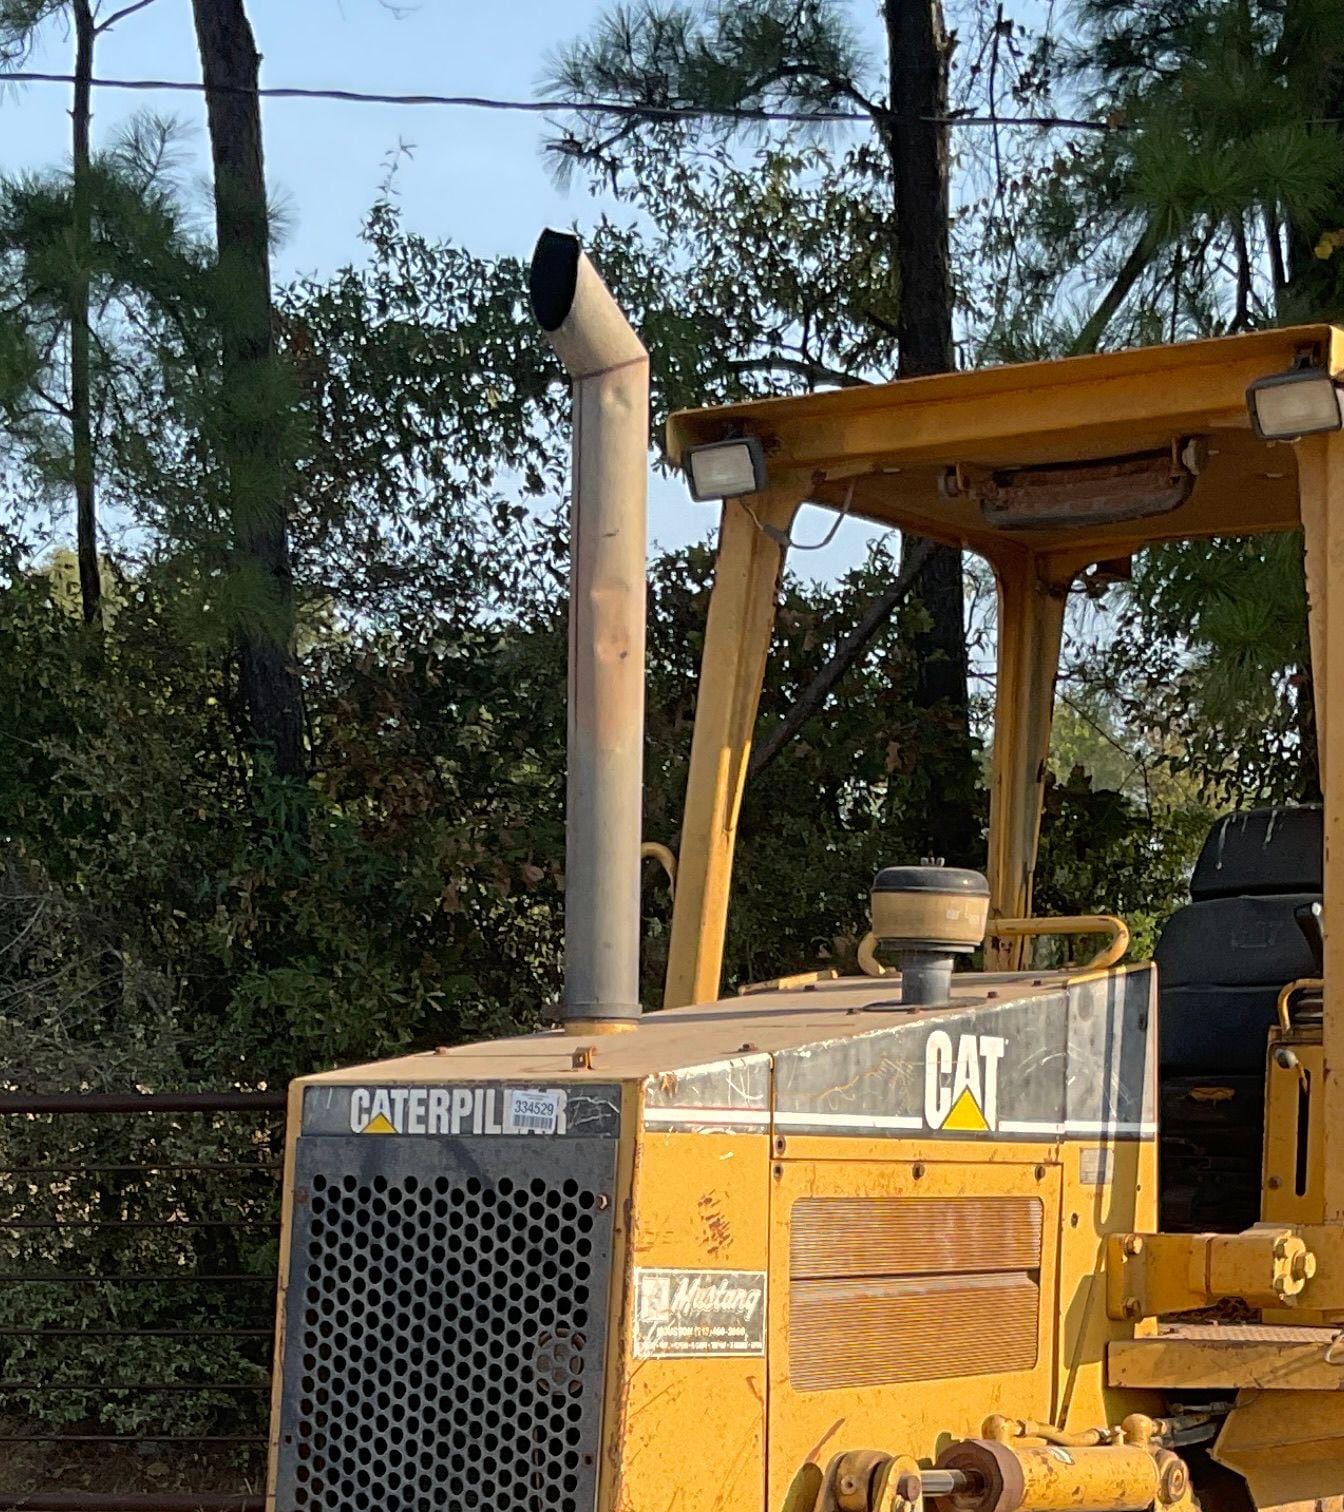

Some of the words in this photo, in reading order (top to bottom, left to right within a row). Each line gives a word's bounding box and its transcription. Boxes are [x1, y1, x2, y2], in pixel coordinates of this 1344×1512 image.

[924, 1030, 1005, 1131] CAT
[514, 1099, 555, 1117] 334529
[670, 1277, 762, 1322] Mustang
